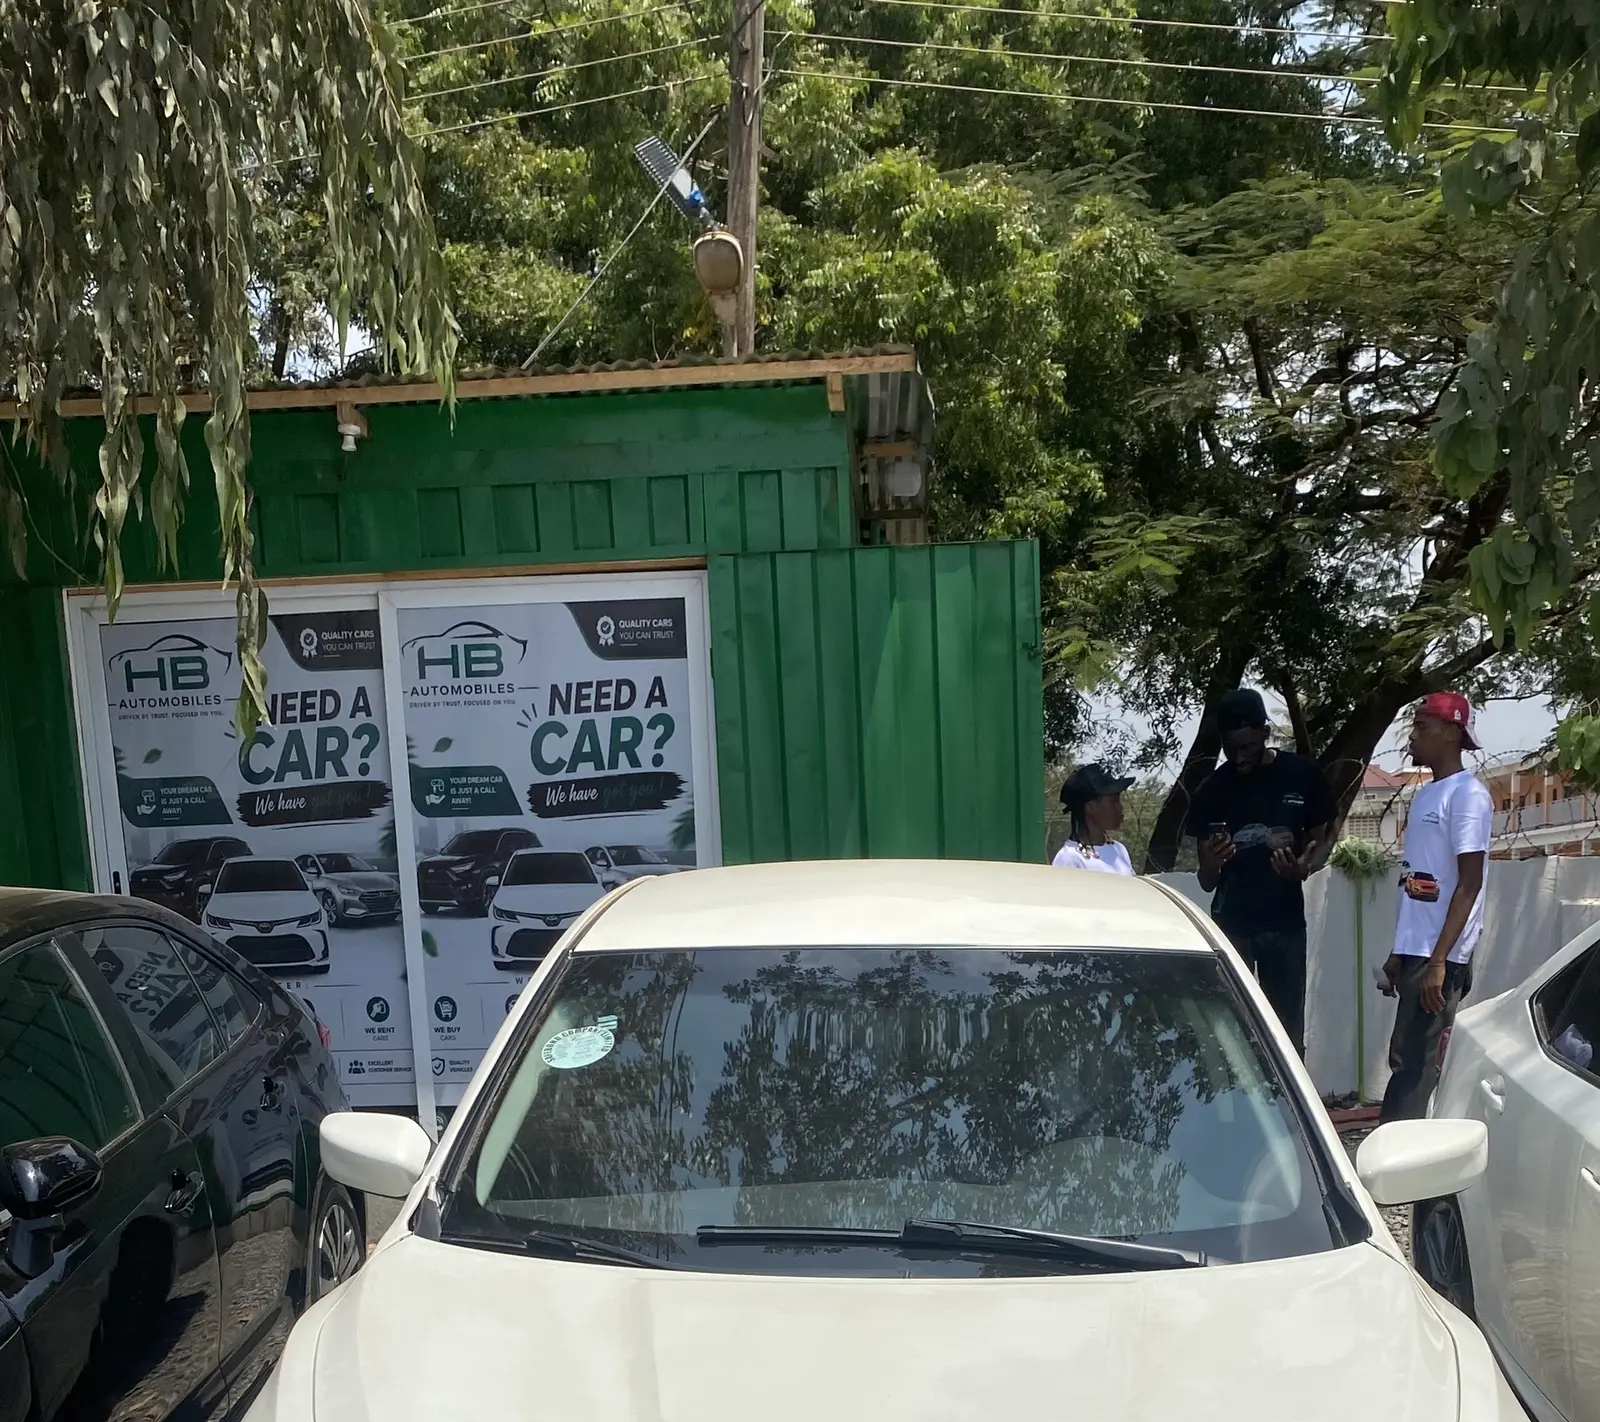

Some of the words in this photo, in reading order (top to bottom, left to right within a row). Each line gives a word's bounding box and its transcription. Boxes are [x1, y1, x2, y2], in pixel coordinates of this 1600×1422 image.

[619, 619, 651, 628] QUALITY
[652, 619, 673, 627] CARS
[321, 630, 353, 640] QUALITY
[354, 630, 375, 638] CARS
[620, 631, 635, 640] YOU
[636, 631, 651, 639] CAN
[652, 630, 674, 639] TRUST
[322, 643, 337, 651] YOU
[338, 642, 353, 651] CAN
[355, 641, 376, 650] TRUST
[418, 643, 504, 680] HB
[124, 656, 210, 692] HB
[410, 683, 515, 697] AUTOMOBILES
[548, 678, 637, 716] NEED
[644, 675, 668, 709] A
[119, 695, 222, 709] AUTOMOBILES
[349, 685, 372, 719] A
[409, 700, 431, 708] DRIVEN
[530, 712, 675, 776] CAR?
[238, 722, 380, 785] CAR?
[468, 776, 489, 784] DREAM
[490, 775, 503, 783] CAR
[160, 787, 177, 795] YOUR
[178, 786, 199, 794] DREAM
[546, 784, 567, 806] We
[569, 783, 598, 802] have
[190, 796, 206, 804] CALL
[255, 794, 275, 815] We
[278, 792, 307, 811] have
[377, 1026, 395, 1034] RENT
